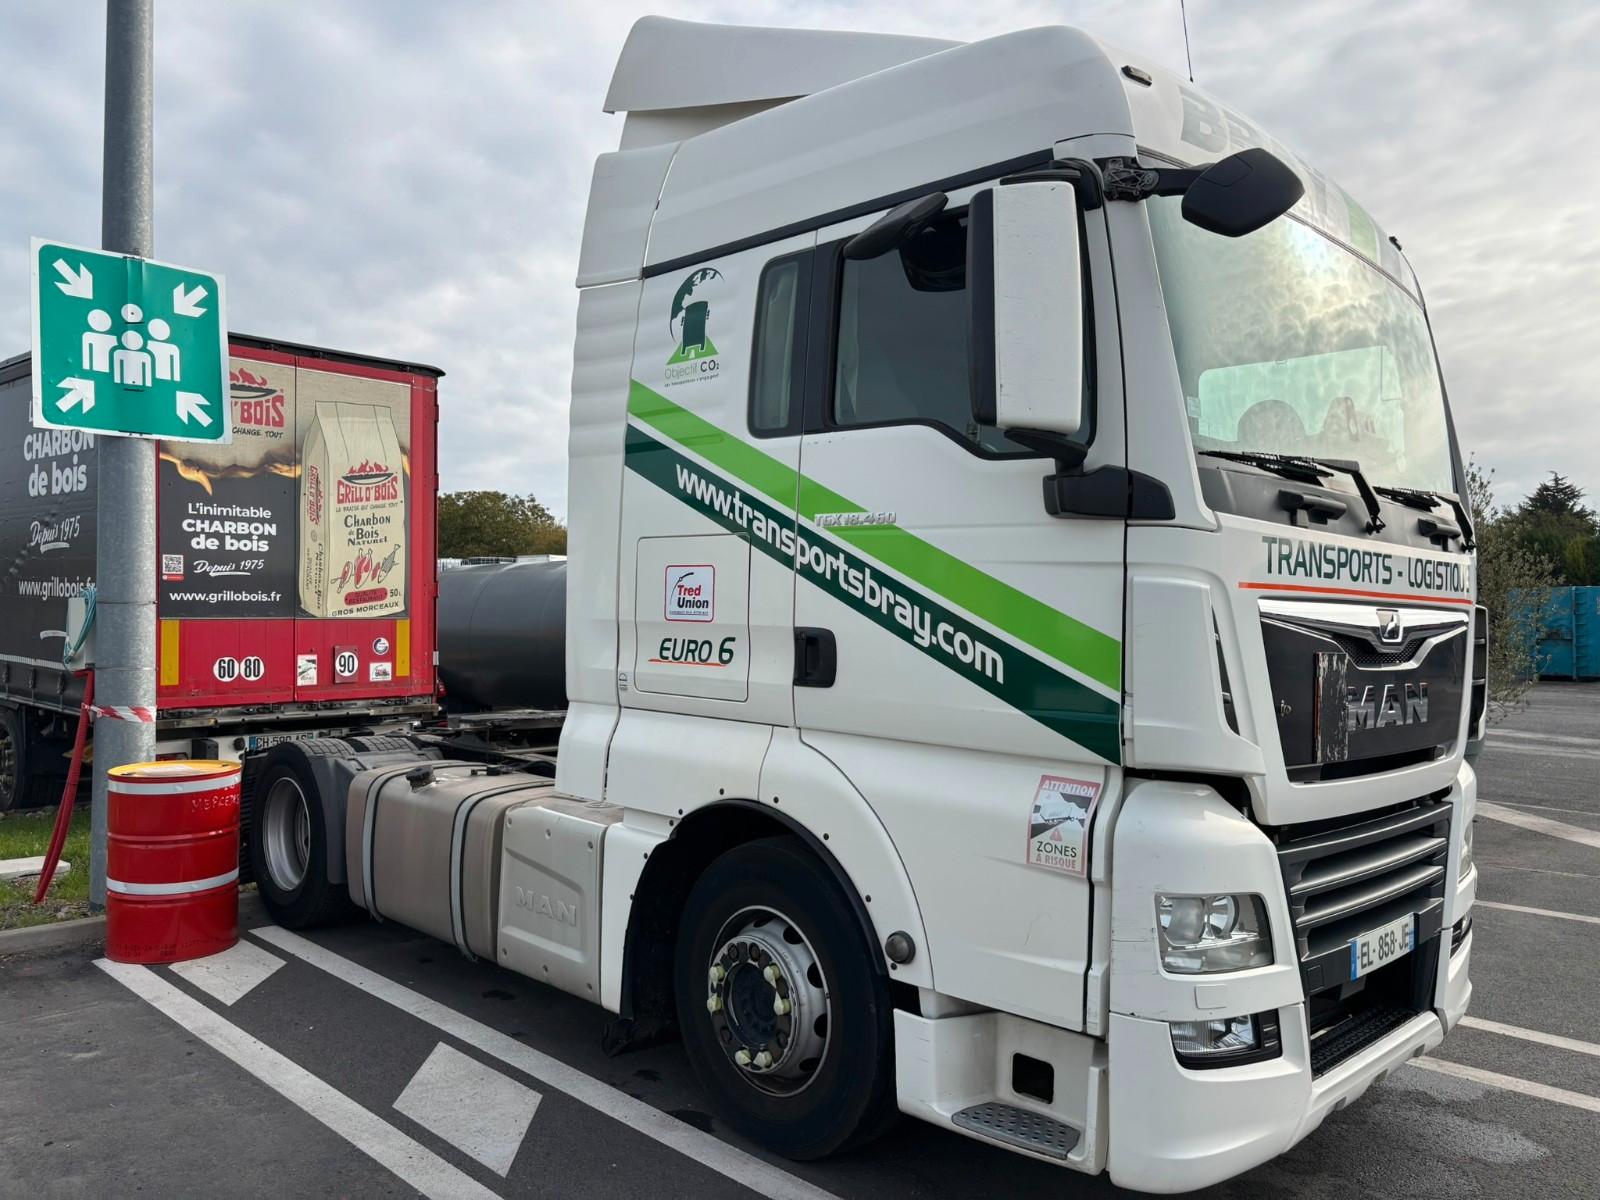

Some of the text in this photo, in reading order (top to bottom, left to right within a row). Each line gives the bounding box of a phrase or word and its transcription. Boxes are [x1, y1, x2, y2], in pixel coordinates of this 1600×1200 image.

[232, 427, 284, 438] CHANGE TOUT
[24, 430, 95, 461] CHARBON
[29, 454, 87, 496] de bois
[188, 502, 272, 519] L'inimitable
[30, 516, 80, 547] Depuis 1975
[182, 519, 277, 536] CHARBON
[355, 526, 379, 540] Bois
[190, 535, 270, 552] de bois
[193, 559, 264, 576] Depuis 1975
[1261, 536, 1393, 585] TRANSPORTS
[676, 463, 1004, 686] www.transportsbray.com
[169, 590, 283, 605] www.grillobois.fr
[677, 584, 702, 597] Tred
[331, 601, 399, 617] GROS MORCEAUX
[677, 597, 710, 609] Union
[659, 636, 736, 665] EURO 6
[217, 657, 261, 678] 60 80
[338, 654, 355, 673] 90
[1347, 682, 1429, 731] MAN
[1042, 779, 1097, 798] ATTENTION
[1036, 840, 1077, 858] ZONES
[1044, 855, 1077, 870] RISQUE
[515, 886, 577, 928] MAN
